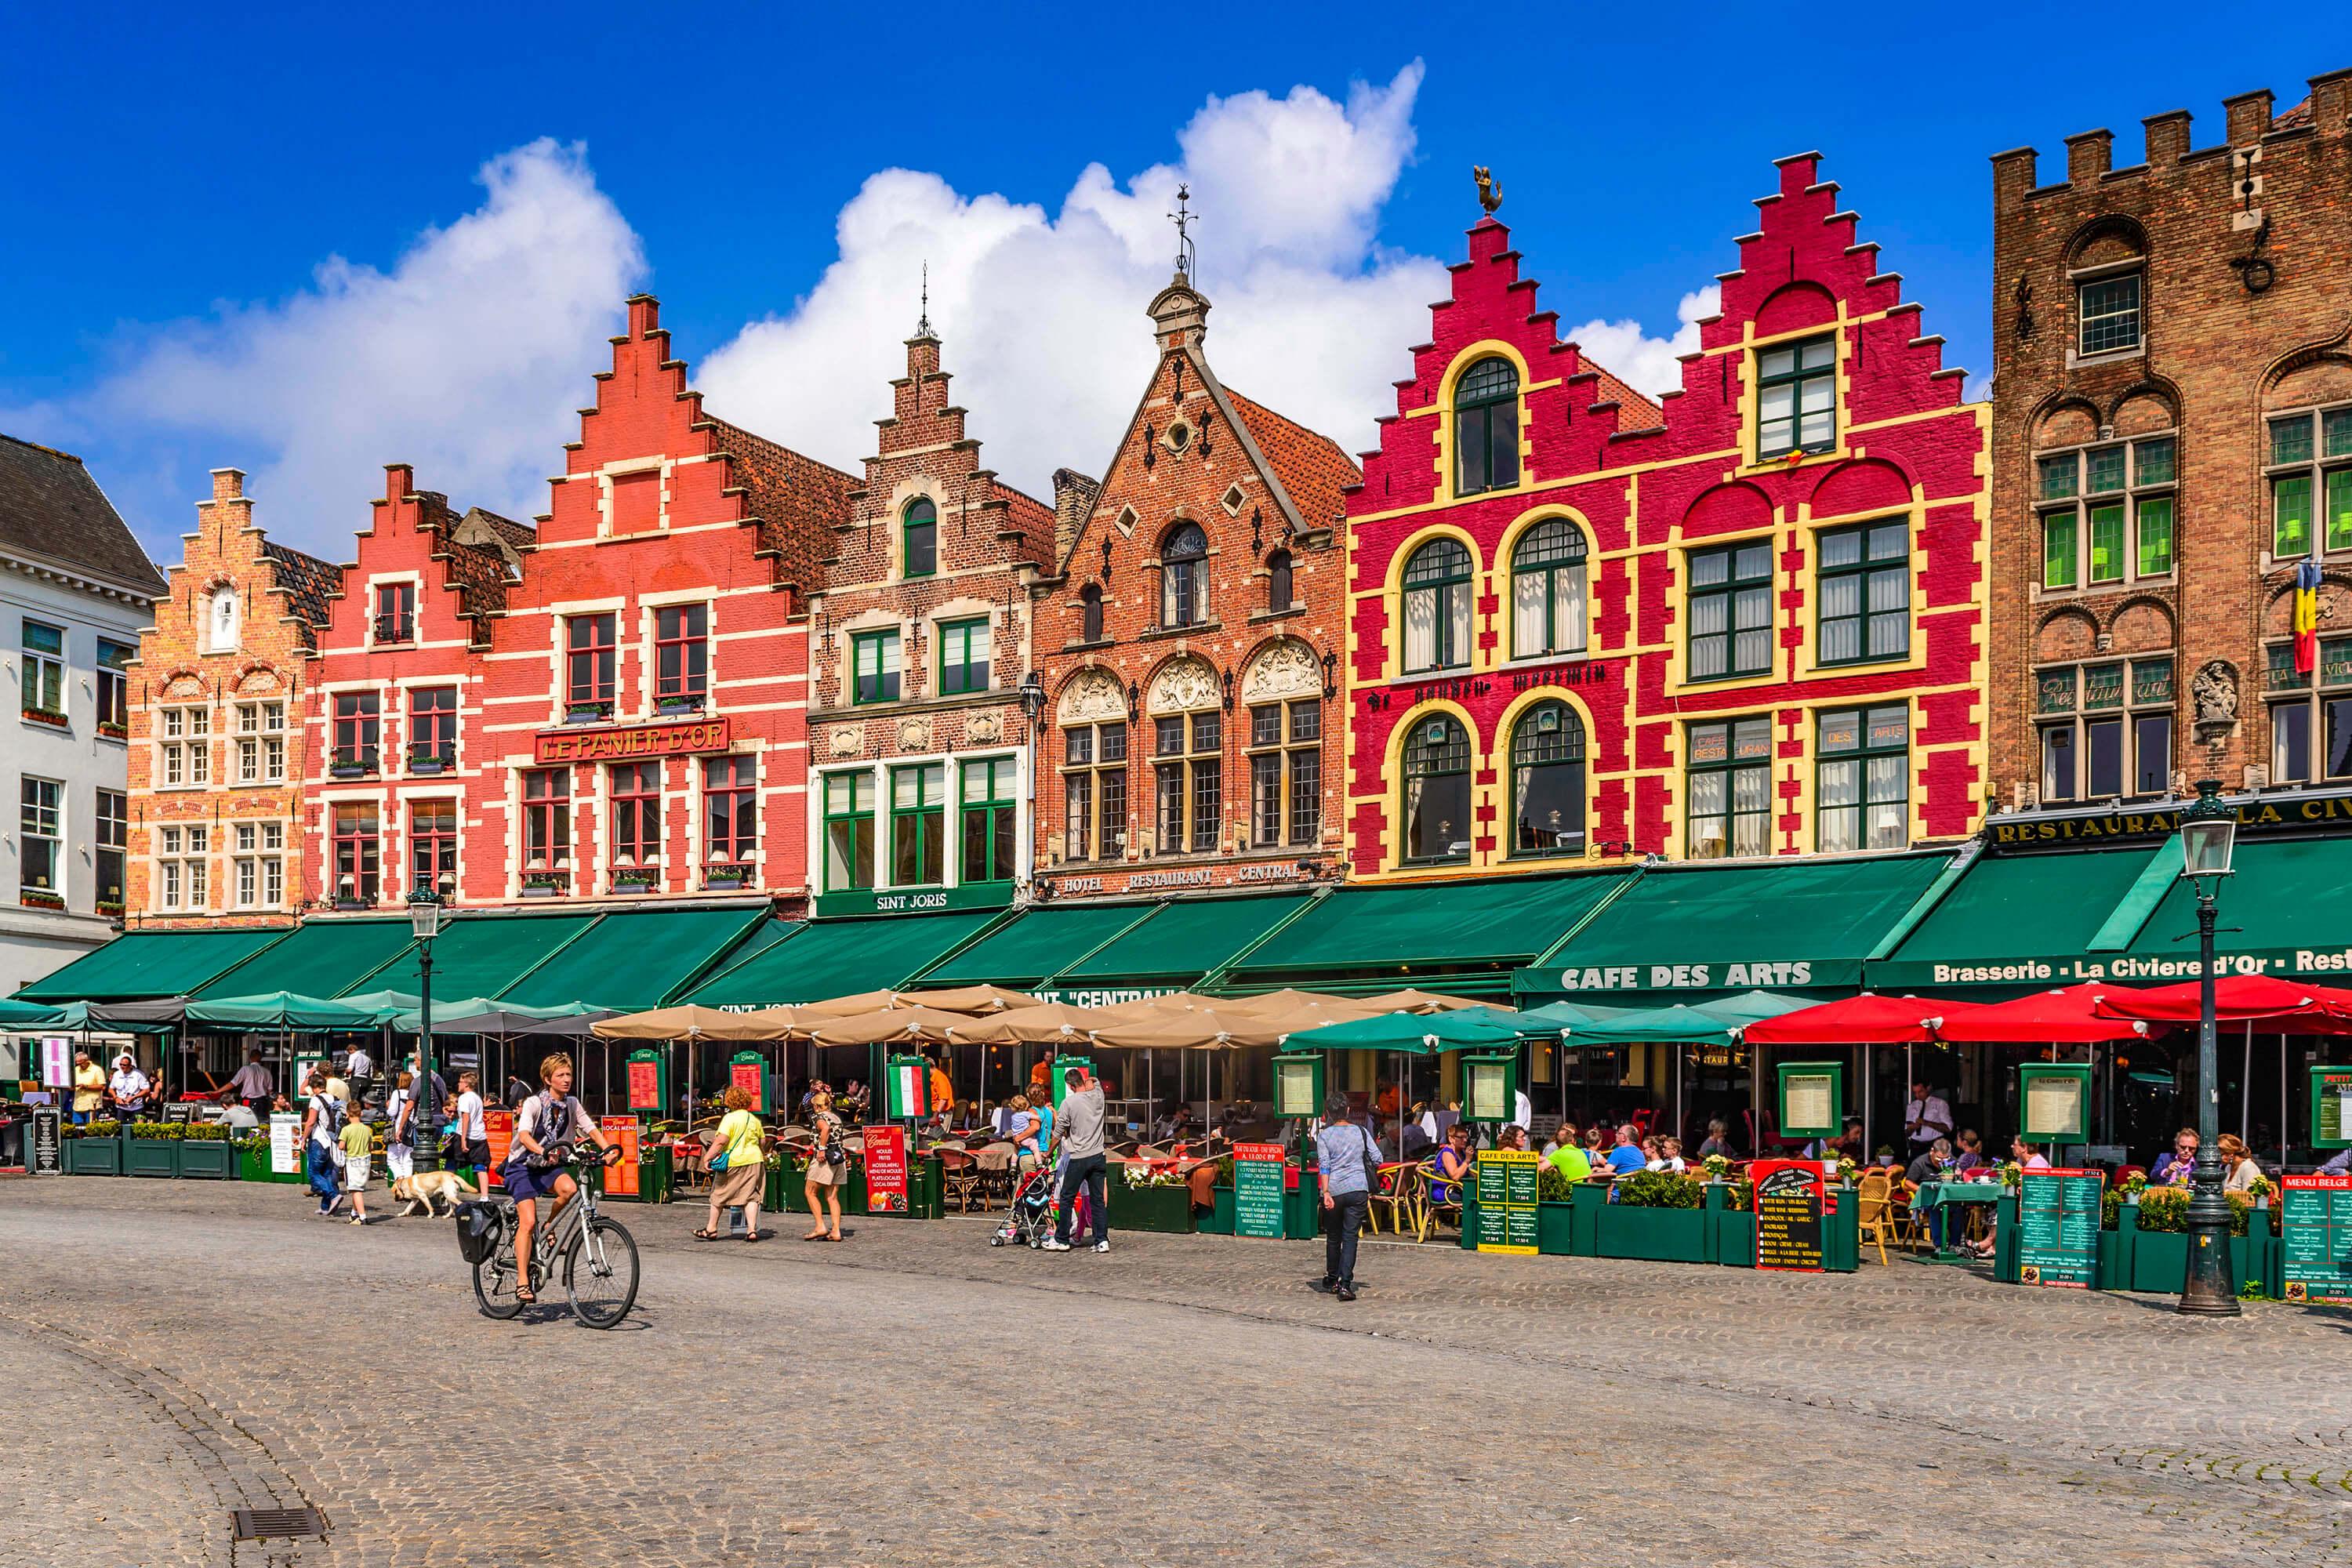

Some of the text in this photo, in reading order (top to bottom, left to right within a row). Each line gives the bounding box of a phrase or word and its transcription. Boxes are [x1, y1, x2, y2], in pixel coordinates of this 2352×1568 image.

[1697, 735, 1725, 746] CAFE
[1828, 725, 1905, 743] DES ARTS
[543, 726, 723, 760] LE PANIER D'OR
[1694, 744, 1770, 760] RESTAURAN
[2238, 804, 2282, 824] LA
[1065, 864, 1299, 892] HOTEL RESTAURANT CENTRAL
[877, 894, 946, 909] SINT JORIS
[1561, 962, 1811, 990] CAFE DES ARTS
[1933, 960, 2051, 983] Brasserie
[2074, 960, 2104, 979] La
[2111, 956, 2202, 978] Civiere
[866, 1134, 891, 1149] Central
[1797, 1169, 1814, 1178] MUSSELS
[1759, 1175, 1774, 1191] MOSSELEN
[2318, 1178, 2350, 1187] BELGE
